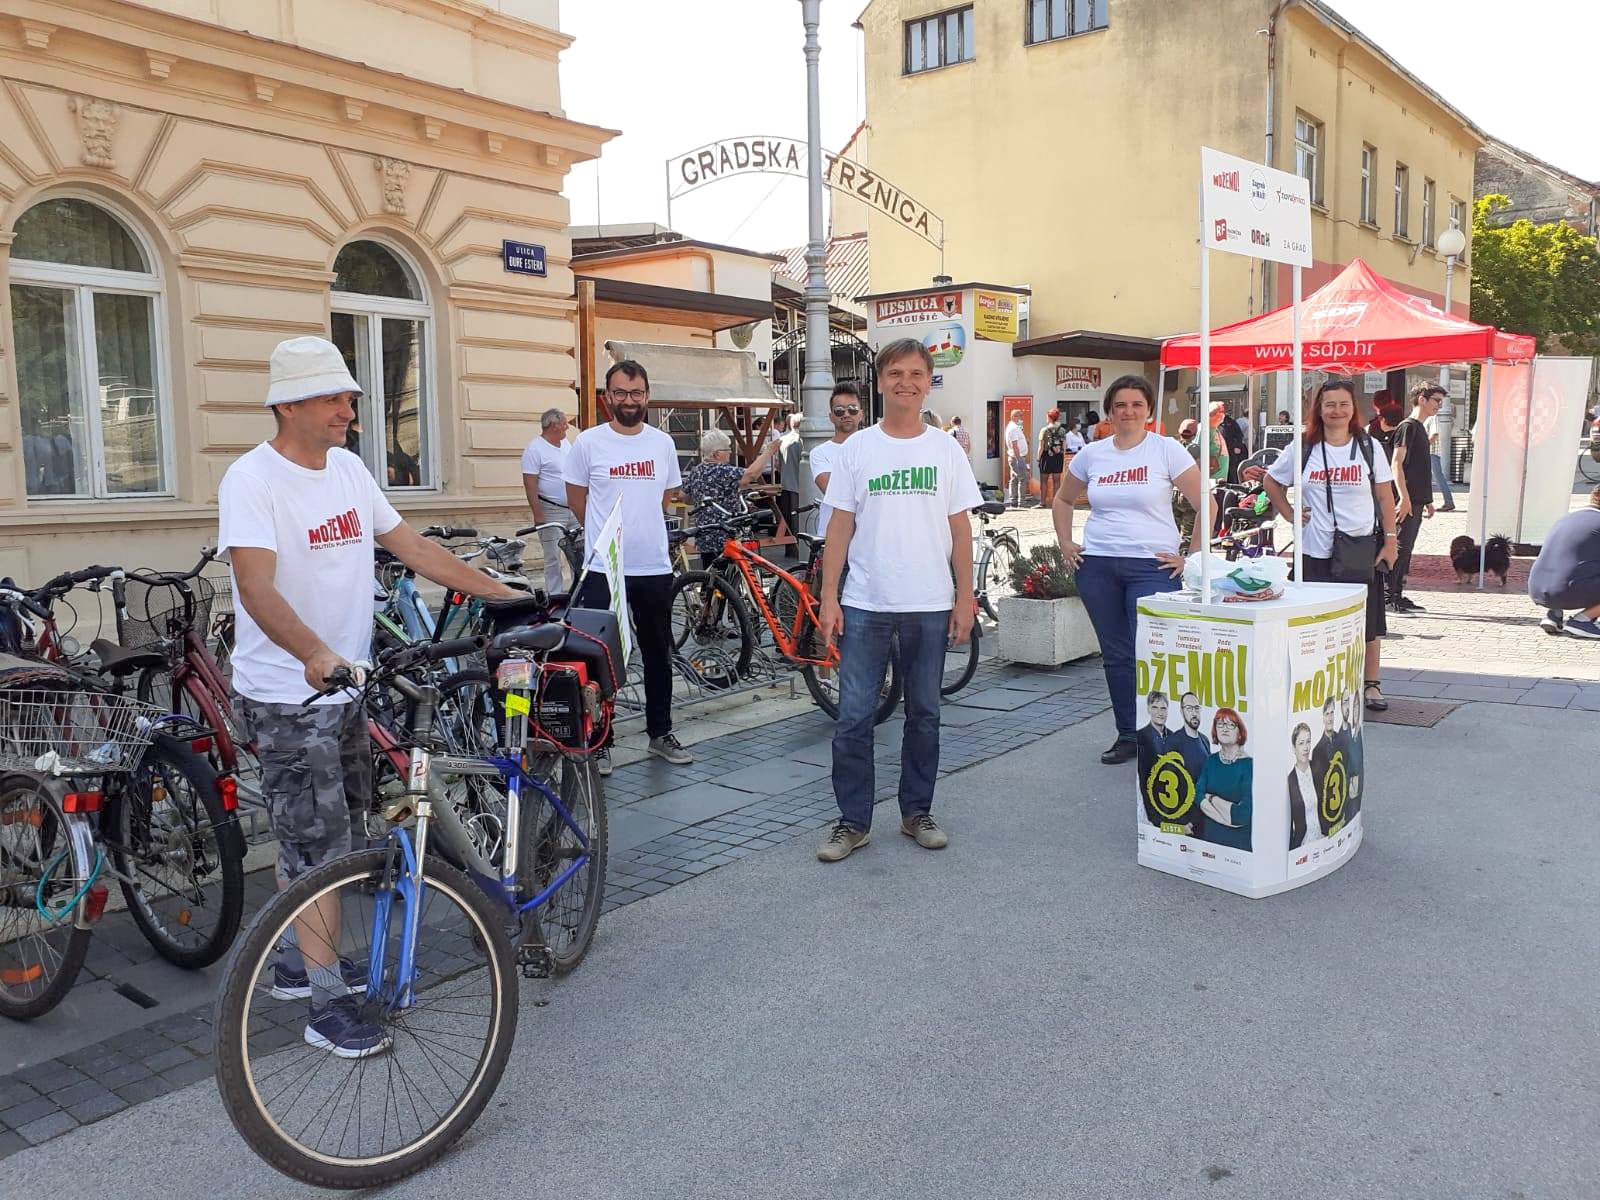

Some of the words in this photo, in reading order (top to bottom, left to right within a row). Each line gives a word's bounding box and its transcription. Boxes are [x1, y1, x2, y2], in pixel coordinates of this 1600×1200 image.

[681, 140, 799, 185] GRADSKA
[823, 153, 929, 236] TRŽNICA
[1213, 170, 1240, 192] MOŽEMO!
[1216, 222, 1226, 238] RF
[515, 246, 535, 256] ULICA
[879, 297, 938, 317] MESNICA
[1254, 339, 1376, 360] www.sdp.hr
[1058, 367, 1089, 381] MESNICA
[609, 459, 655, 477] MOŽEMO!
[868, 465, 937, 491] MOŽEMO!
[1098, 465, 1148, 484] MOŽEMO!
[1309, 464, 1361, 482] MOŽEMO!
[308, 507, 362, 544] MOŽEMO!
[1158, 769, 1179, 809] 3
[1328, 771, 1341, 811] 3
